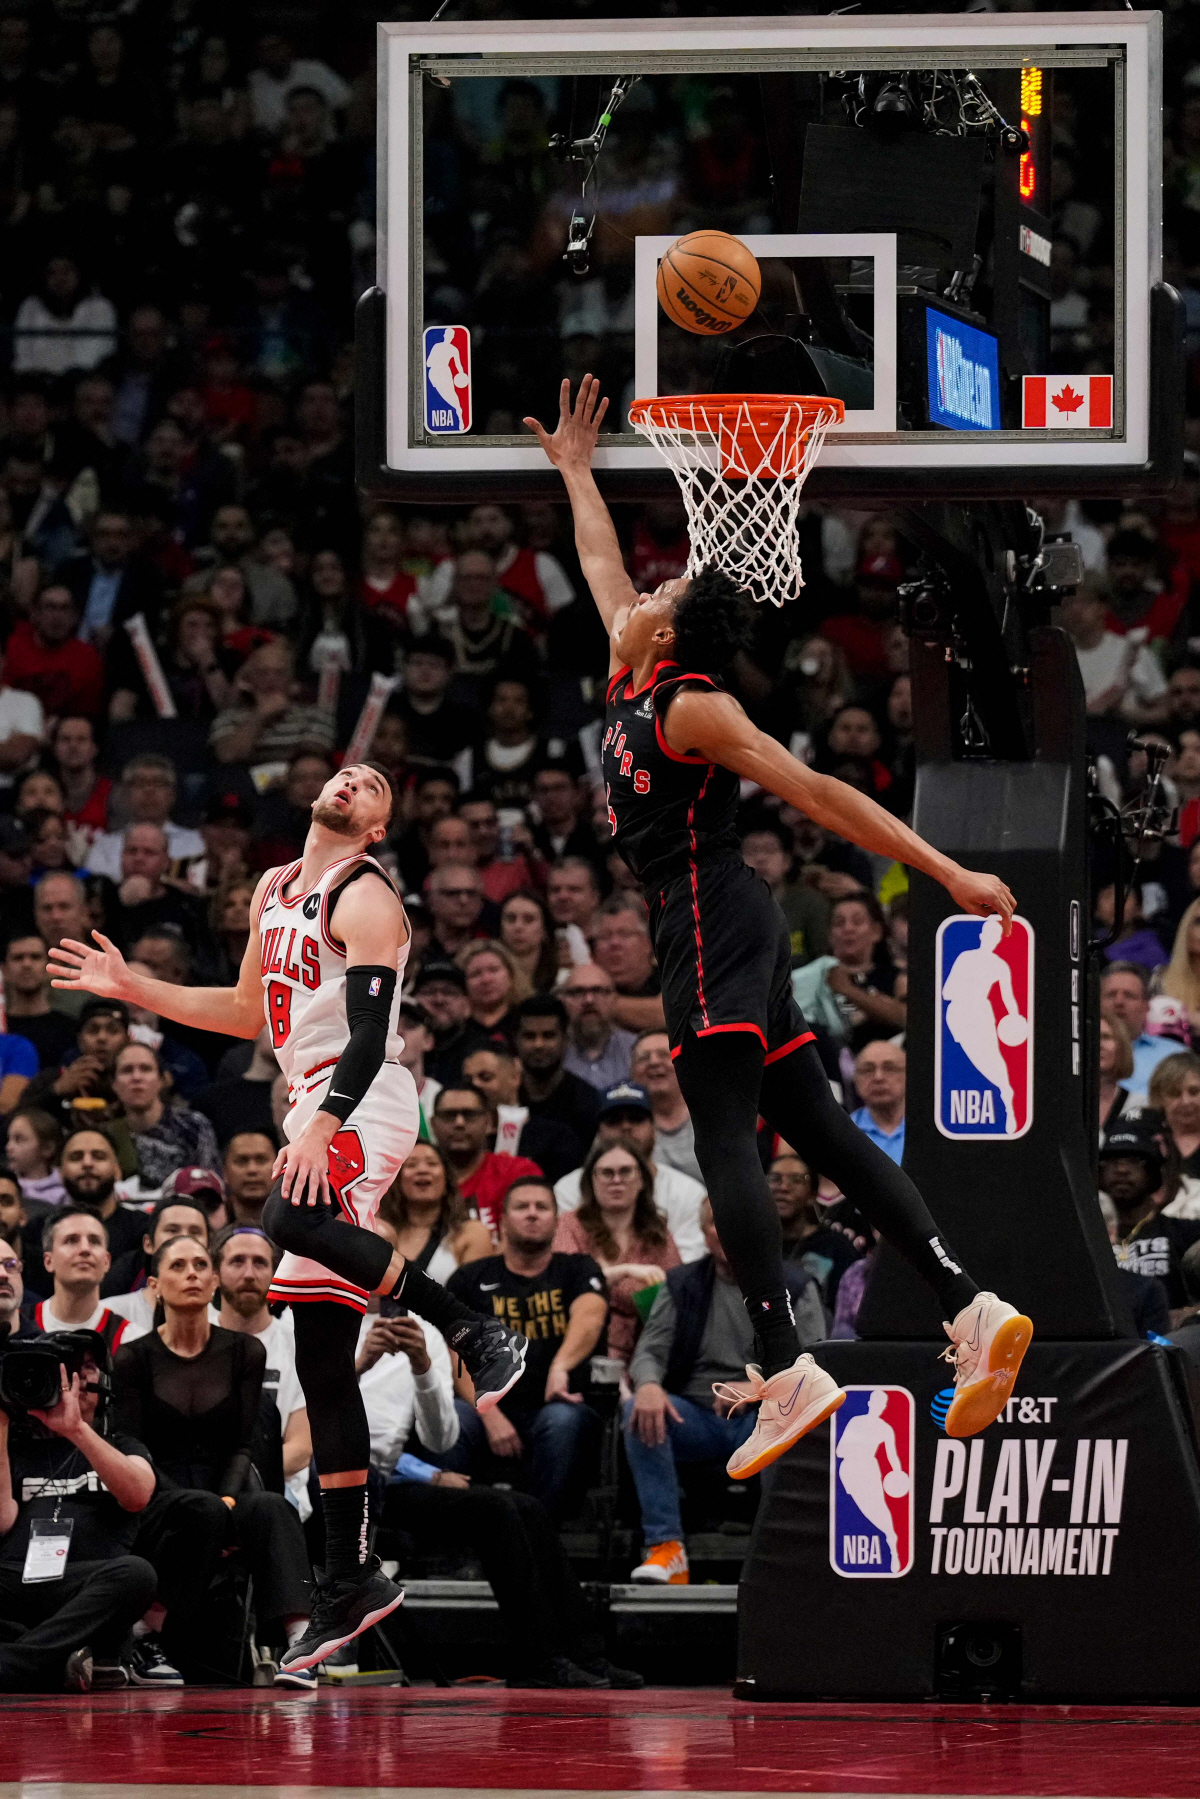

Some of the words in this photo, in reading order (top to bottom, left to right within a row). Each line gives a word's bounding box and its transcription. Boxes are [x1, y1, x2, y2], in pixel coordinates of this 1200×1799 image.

[432, 410, 454, 427] NBA
[601, 721, 650, 794] PTORS
[261, 927, 321, 990] ULLS
[951, 1090, 995, 1124] NBA
[492, 1295, 520, 1317] WE
[526, 1289, 564, 1318] THE
[996, 1397, 1058, 1424] T&T
[929, 1439, 1128, 1524] PLAY-IN
[843, 1535, 882, 1565] NBA
[930, 1527, 1119, 1575] TOURNAMENT
